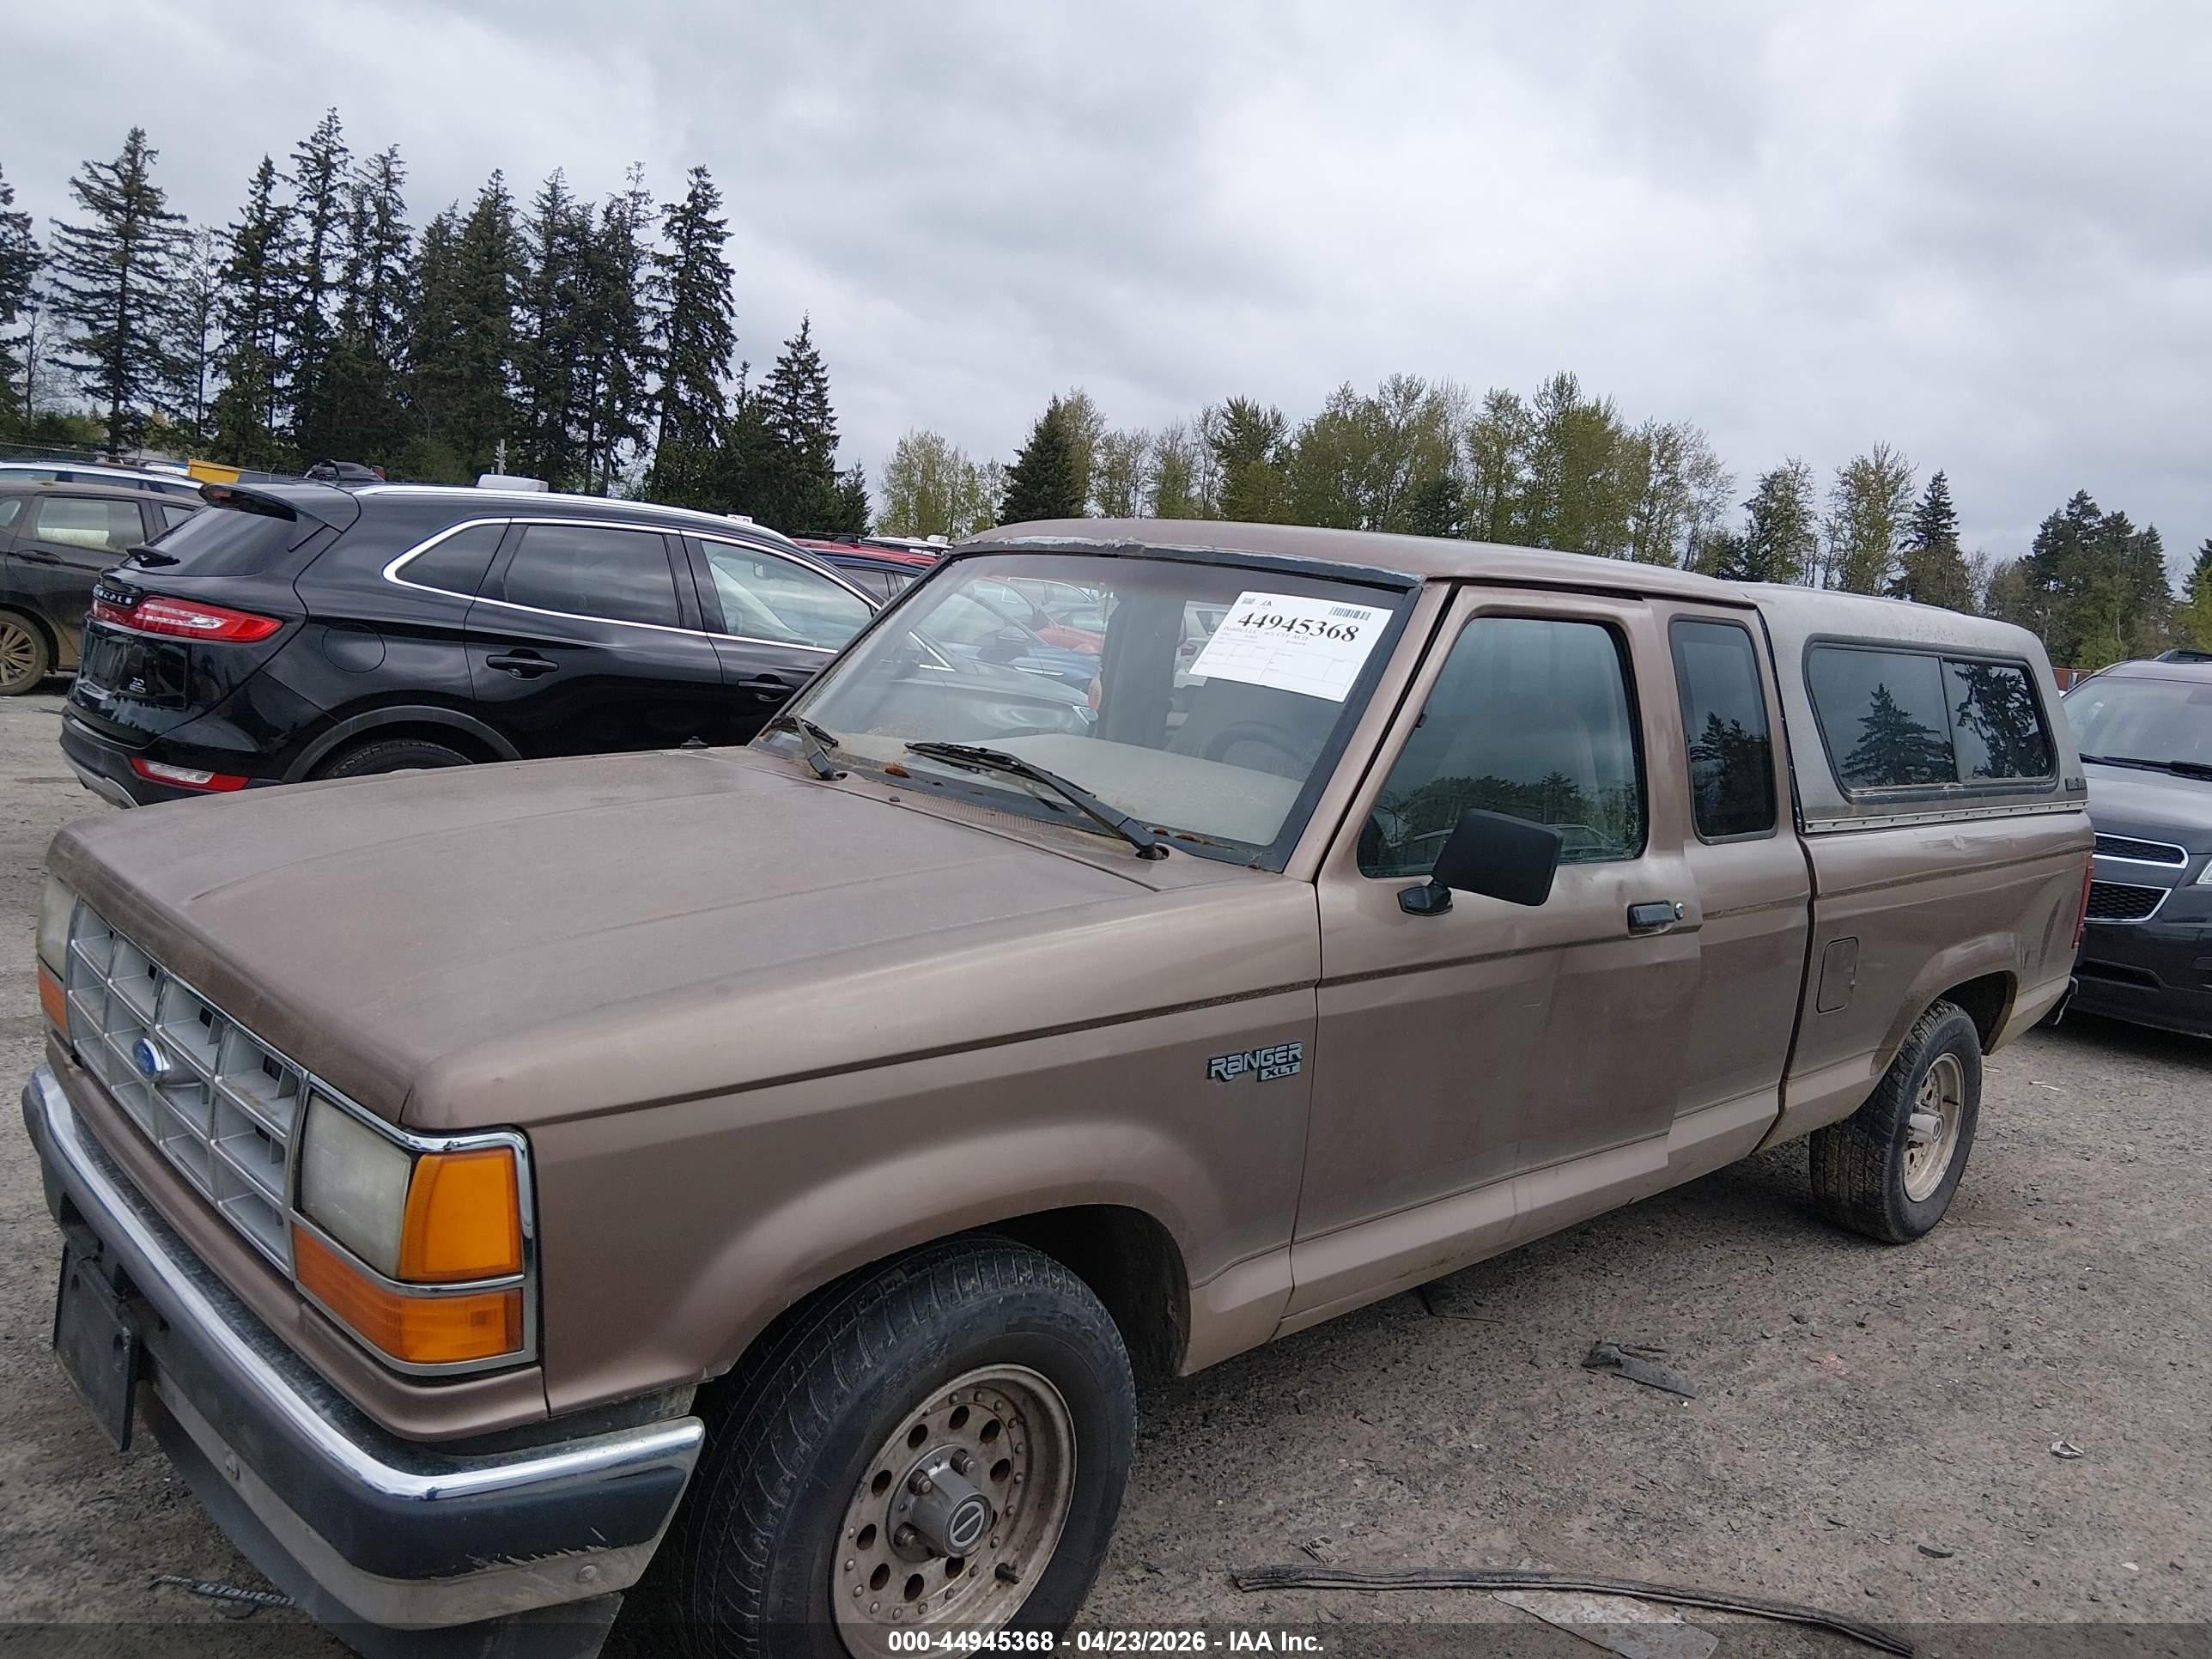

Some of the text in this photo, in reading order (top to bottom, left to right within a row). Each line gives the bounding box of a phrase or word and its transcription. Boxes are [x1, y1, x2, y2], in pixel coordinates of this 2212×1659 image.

[1237, 611, 1359, 642] 44945368
[1209, 1042, 1303, 1080] RANGER
[1264, 1063, 1297, 1079] XLT
